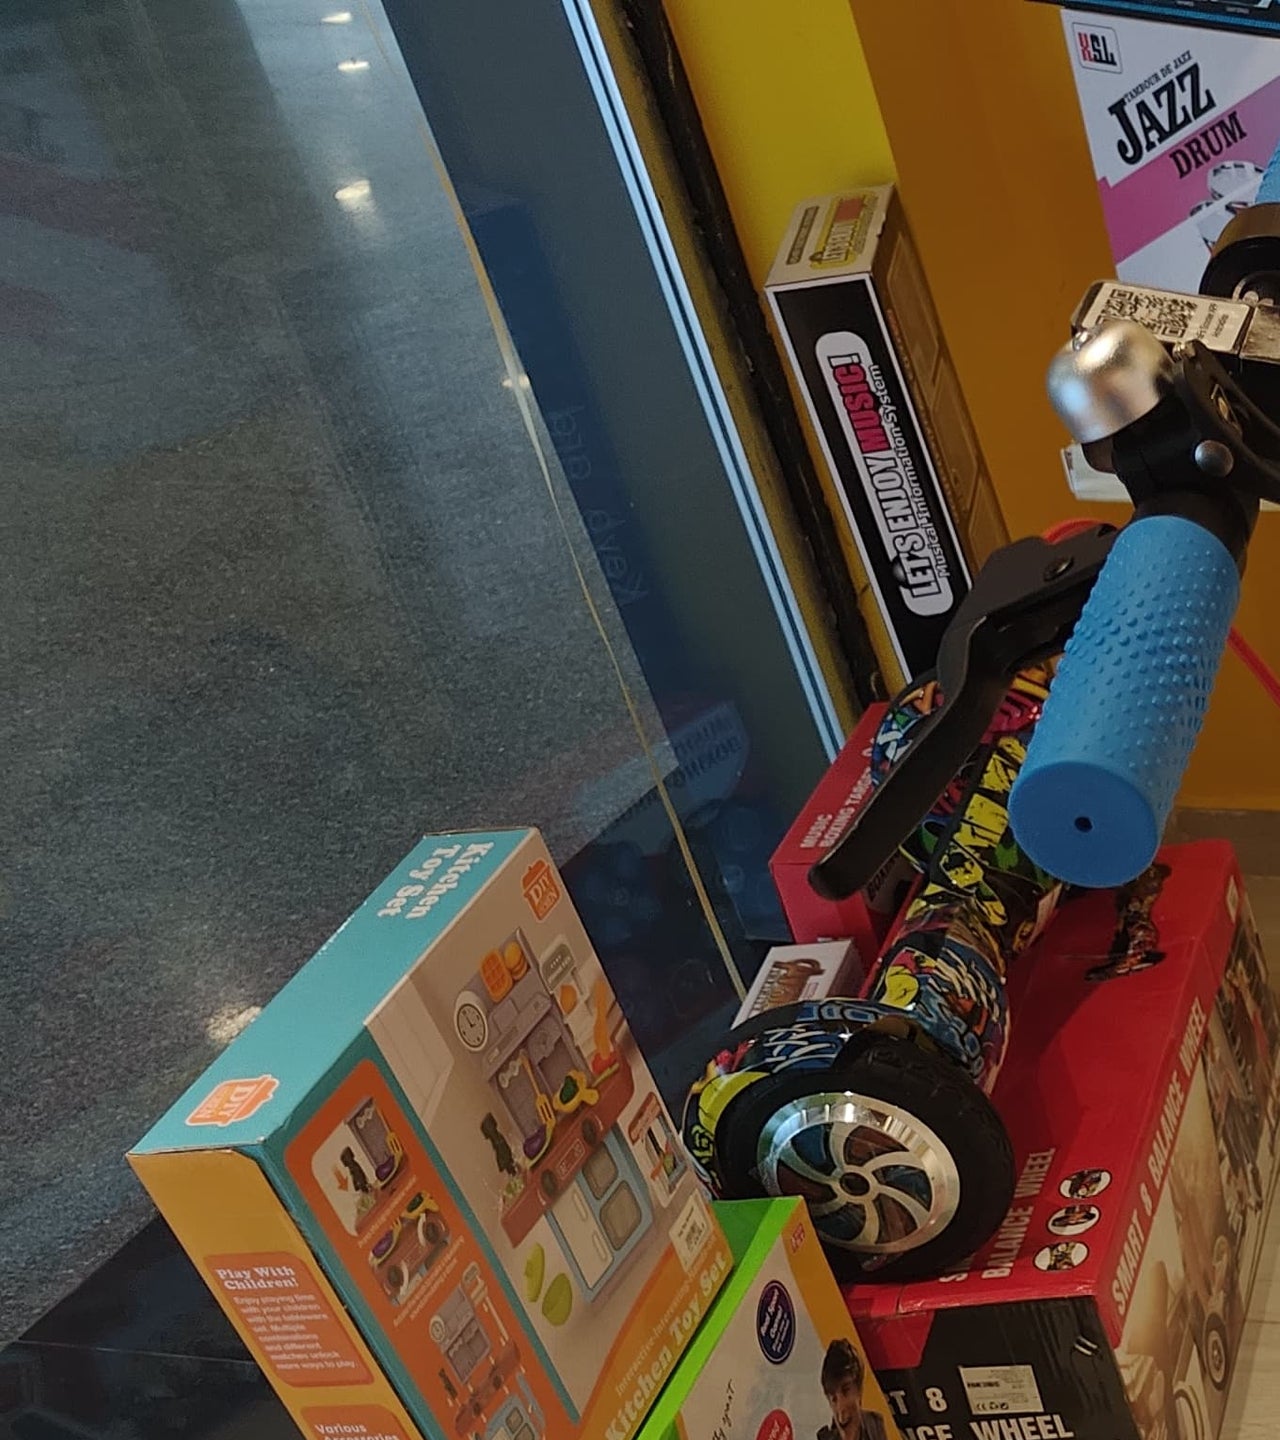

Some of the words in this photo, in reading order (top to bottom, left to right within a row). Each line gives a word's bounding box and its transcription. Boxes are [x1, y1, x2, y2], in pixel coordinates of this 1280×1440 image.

[1160, 64, 1173, 79] DE
[1107, 62, 1217, 165] JAZZ
[1169, 110, 1247, 179] DRUM
[826, 351, 890, 453] MUSIC!
[870, 364, 898, 424] System
[863, 450, 920, 530] ENJOY
[892, 423, 930, 522] Information
[893, 528, 942, 599] LET'S
[920, 521, 952, 578] Musical
[405, 842, 494, 919] Kitchen
[409, 844, 462, 881] Toy
[377, 884, 424, 917] Set
[1180, 997, 1207, 1080] WHEEL
[1147, 1072, 1184, 1181] BALANCE
[982, 1205, 1033, 1280] BALANCE
[1014, 1147, 1056, 1205] WHEEL
[1141, 1190, 1161, 1213] 8
[215, 1268, 251, 1280] Play
[253, 1266, 296, 1278] With
[223, 1279, 299, 1290] Children!
[1110, 1208, 1152, 1316] SMART
[669, 1297, 702, 1345] Toy
[700, 1251, 728, 1297] Set
[315, 1424, 367, 1434] Various
[925, 1387, 948, 1412] 8
